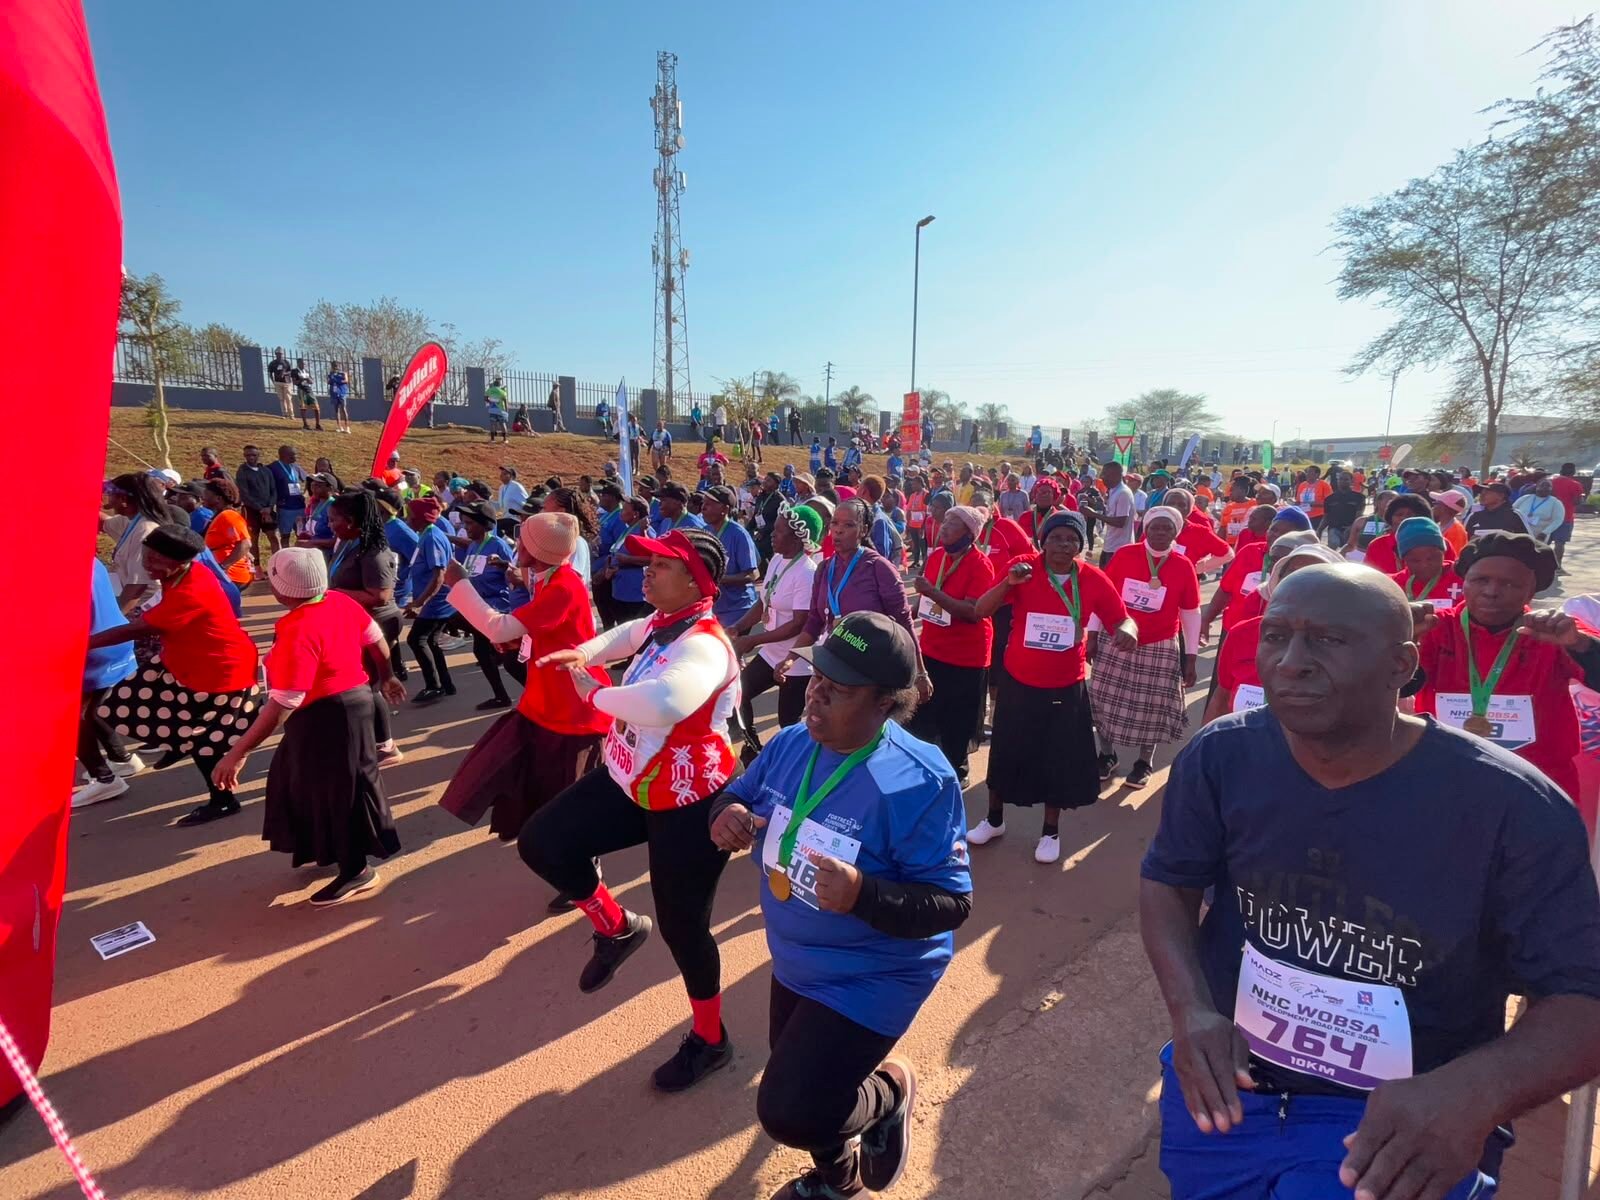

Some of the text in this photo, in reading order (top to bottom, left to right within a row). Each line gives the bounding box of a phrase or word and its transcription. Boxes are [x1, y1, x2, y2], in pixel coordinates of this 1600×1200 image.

[399, 361, 429, 408] Build
[1133, 594, 1149, 605] 79
[1038, 631, 1060, 643] 90
[1250, 957, 1283, 981] MADZ
[1251, 983, 1380, 1038] NHC WOBSA
[1256, 998, 1309, 1024] DEVELOPMENT
[1310, 1019, 1333, 1031] ROAD
[1334, 1026, 1357, 1038] RACE
[1357, 1033, 1379, 1044] 2026
[1260, 1010, 1368, 1071] 764
[1290, 1055, 1336, 1077] 10KM
